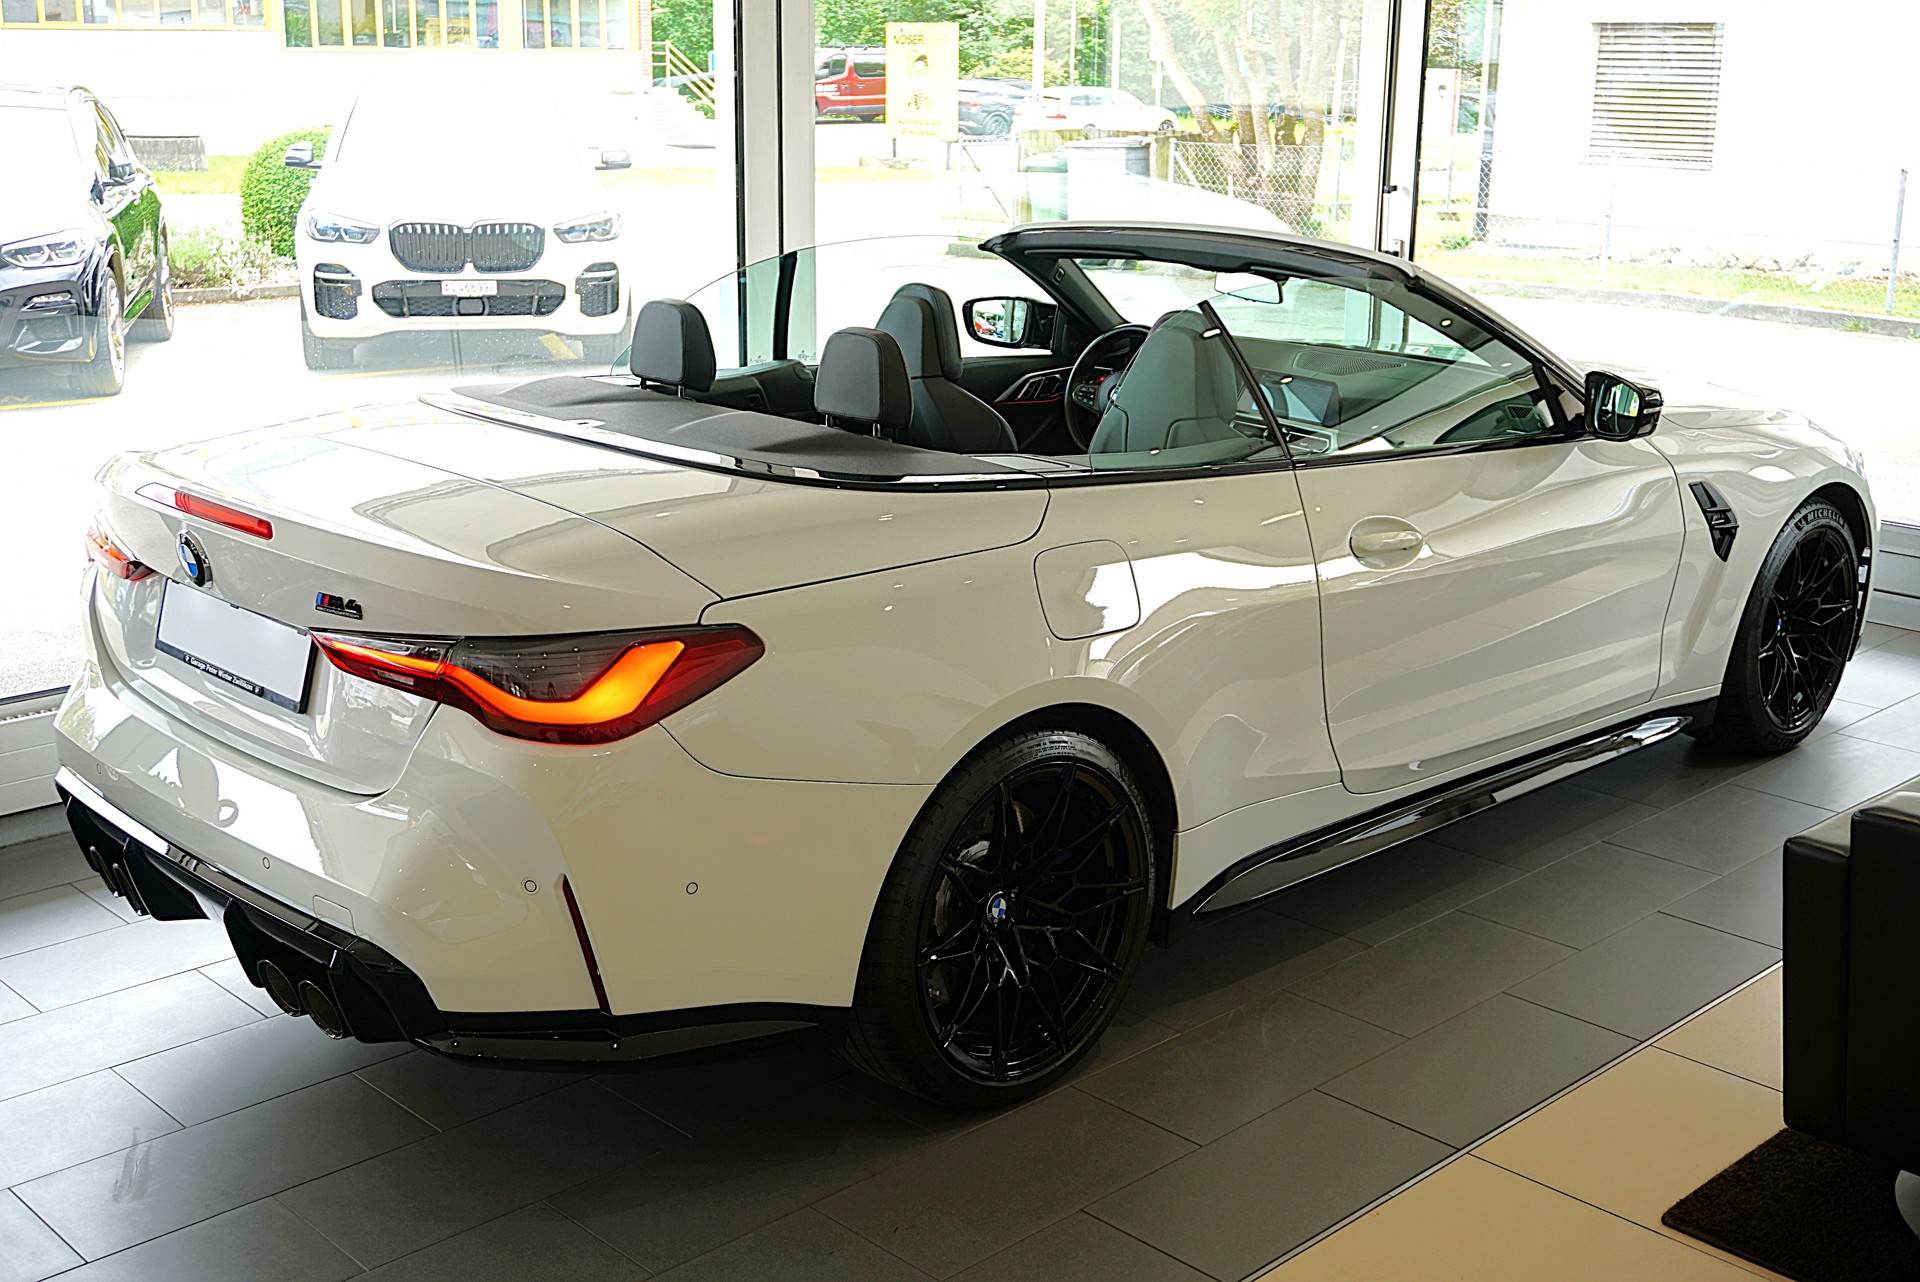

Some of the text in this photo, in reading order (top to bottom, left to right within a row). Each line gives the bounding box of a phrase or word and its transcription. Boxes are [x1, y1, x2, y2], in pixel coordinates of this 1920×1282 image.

[1807, 508, 1844, 527] MICHELIN
[322, 593, 362, 614] M4
[190, 657, 206, 670] Garage
[205, 663, 218, 675] Peter
